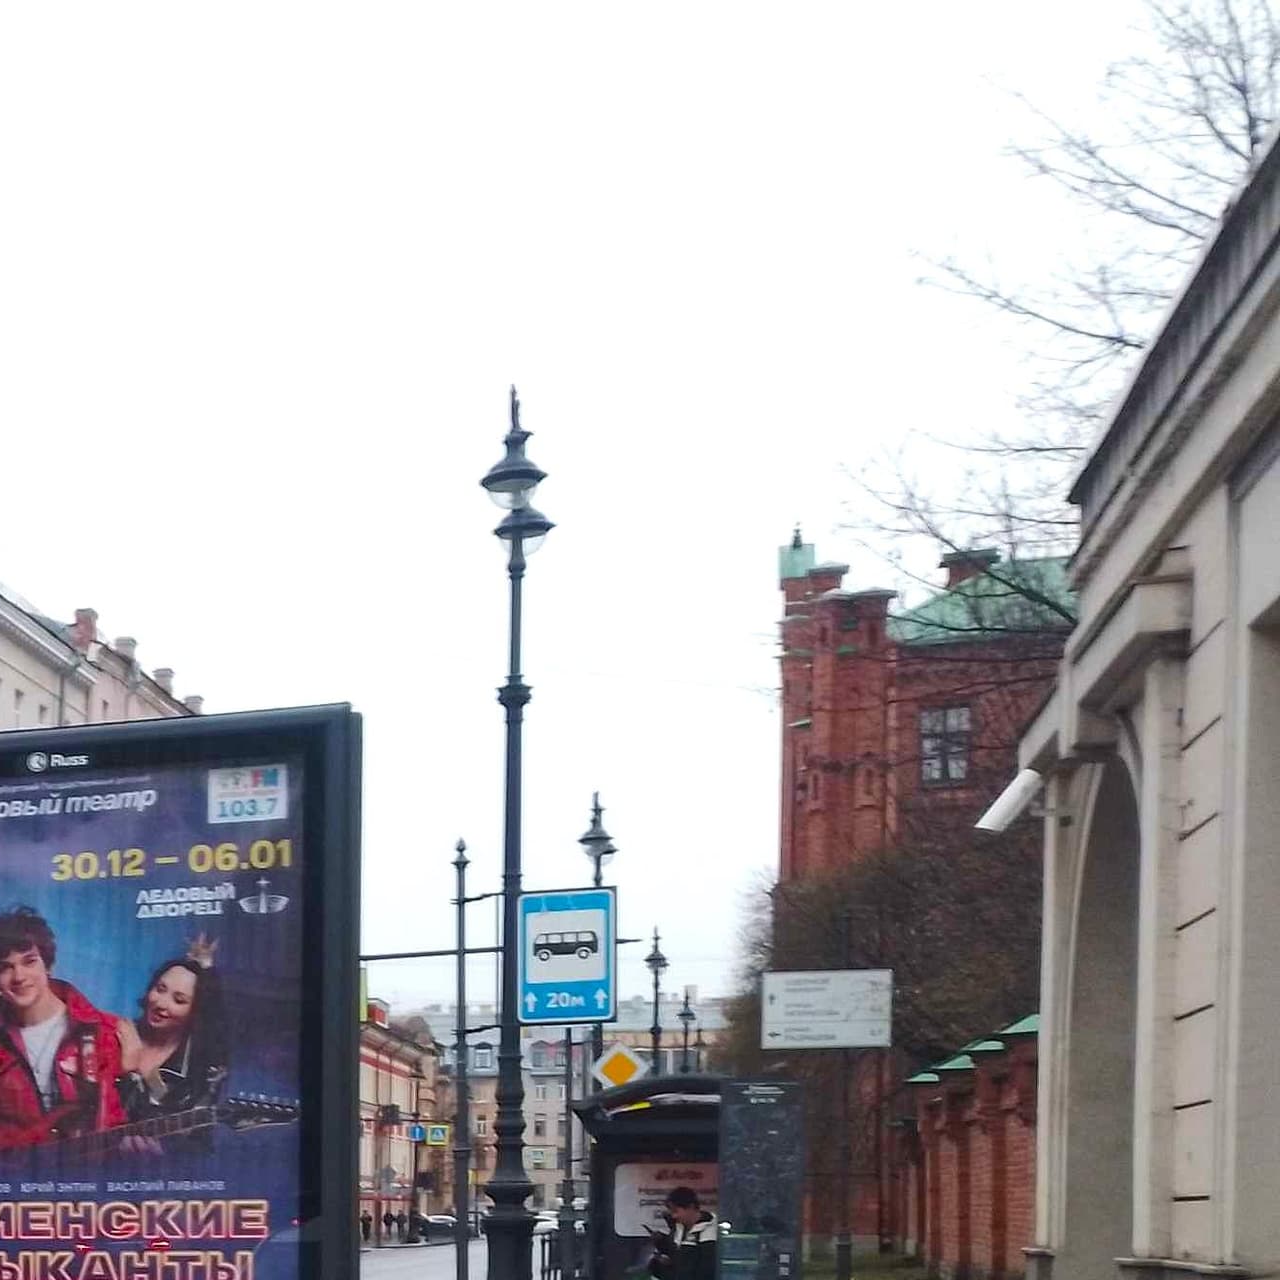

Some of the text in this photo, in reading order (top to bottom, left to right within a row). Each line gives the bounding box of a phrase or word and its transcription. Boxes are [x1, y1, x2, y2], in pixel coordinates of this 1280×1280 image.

[50, 753, 88, 767] Russ
[65, 789, 157, 812] театр
[216, 797, 278, 817] 103.7
[51, 848, 146, 881] 30.12
[188, 839, 292, 873] 06.01
[136, 882, 236, 904] ЛЕДОВЫЙ
[136, 901, 224, 918] ДВОРЕЦ
